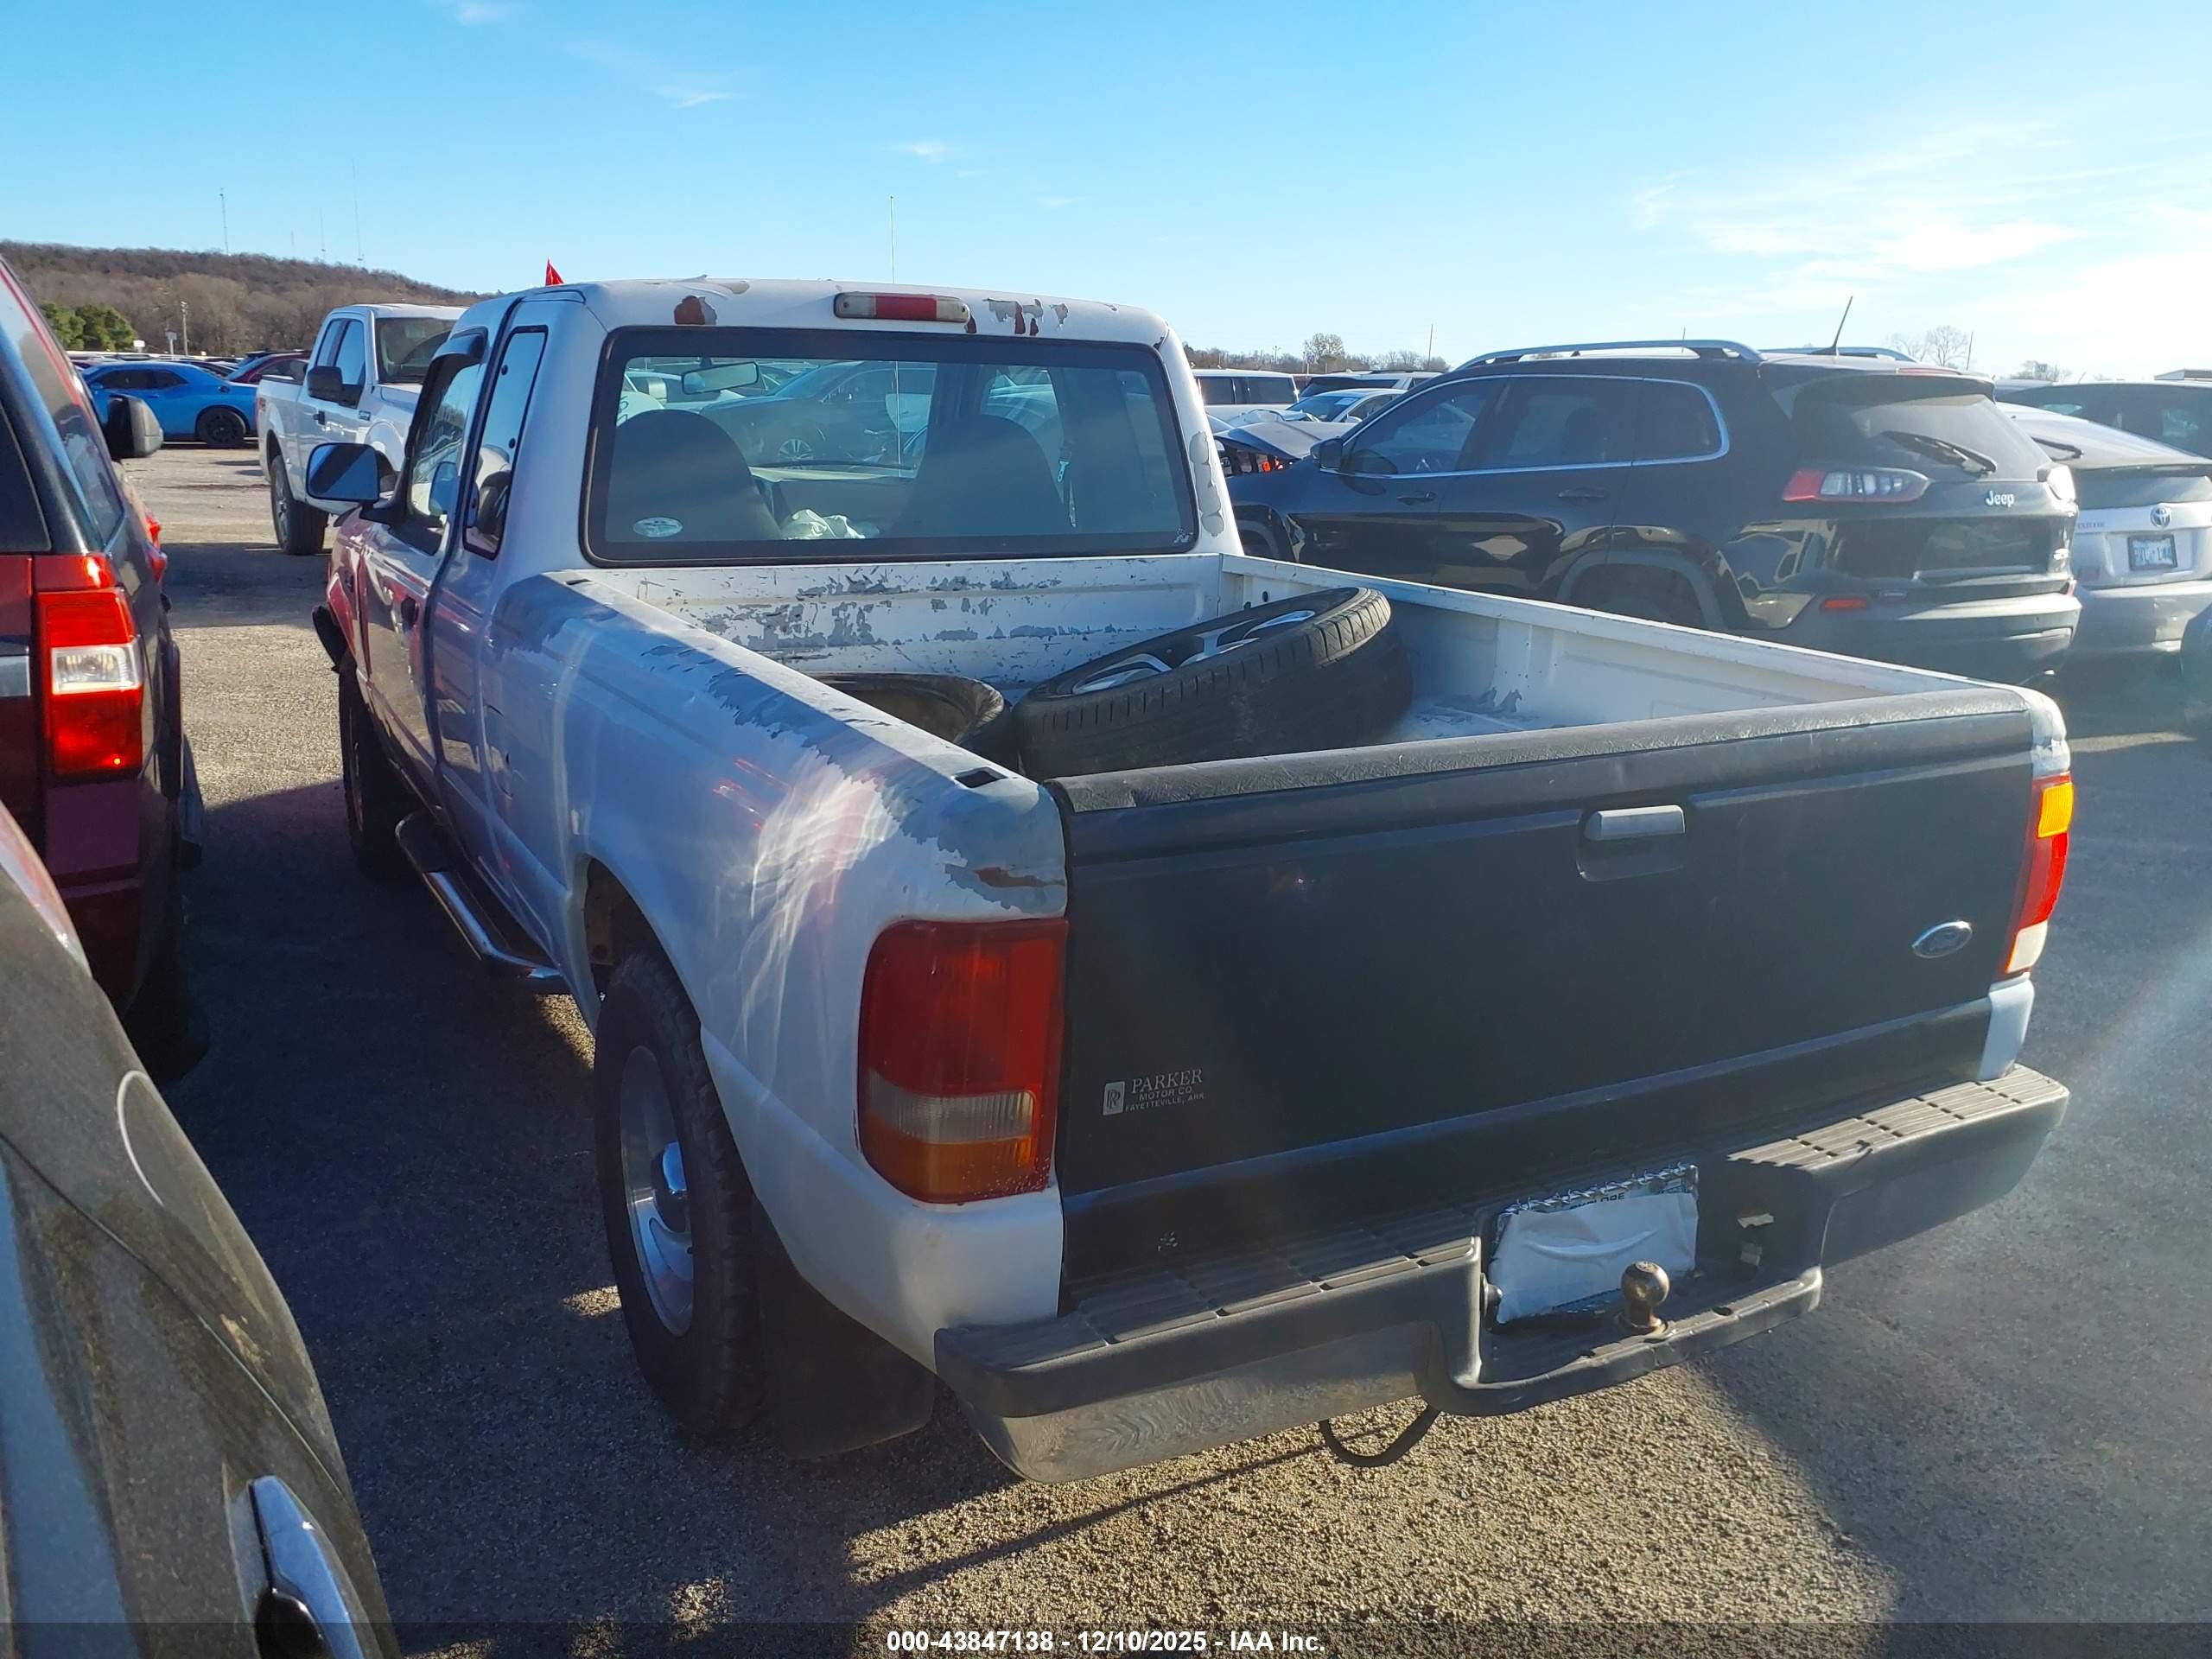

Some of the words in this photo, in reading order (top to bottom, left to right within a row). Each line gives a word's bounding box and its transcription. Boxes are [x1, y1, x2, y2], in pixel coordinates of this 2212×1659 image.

[1986, 490, 2015, 508] Jeep
[1132, 1069, 1203, 1094] PARKER
[1139, 1089, 1175, 1102] MOTOR
